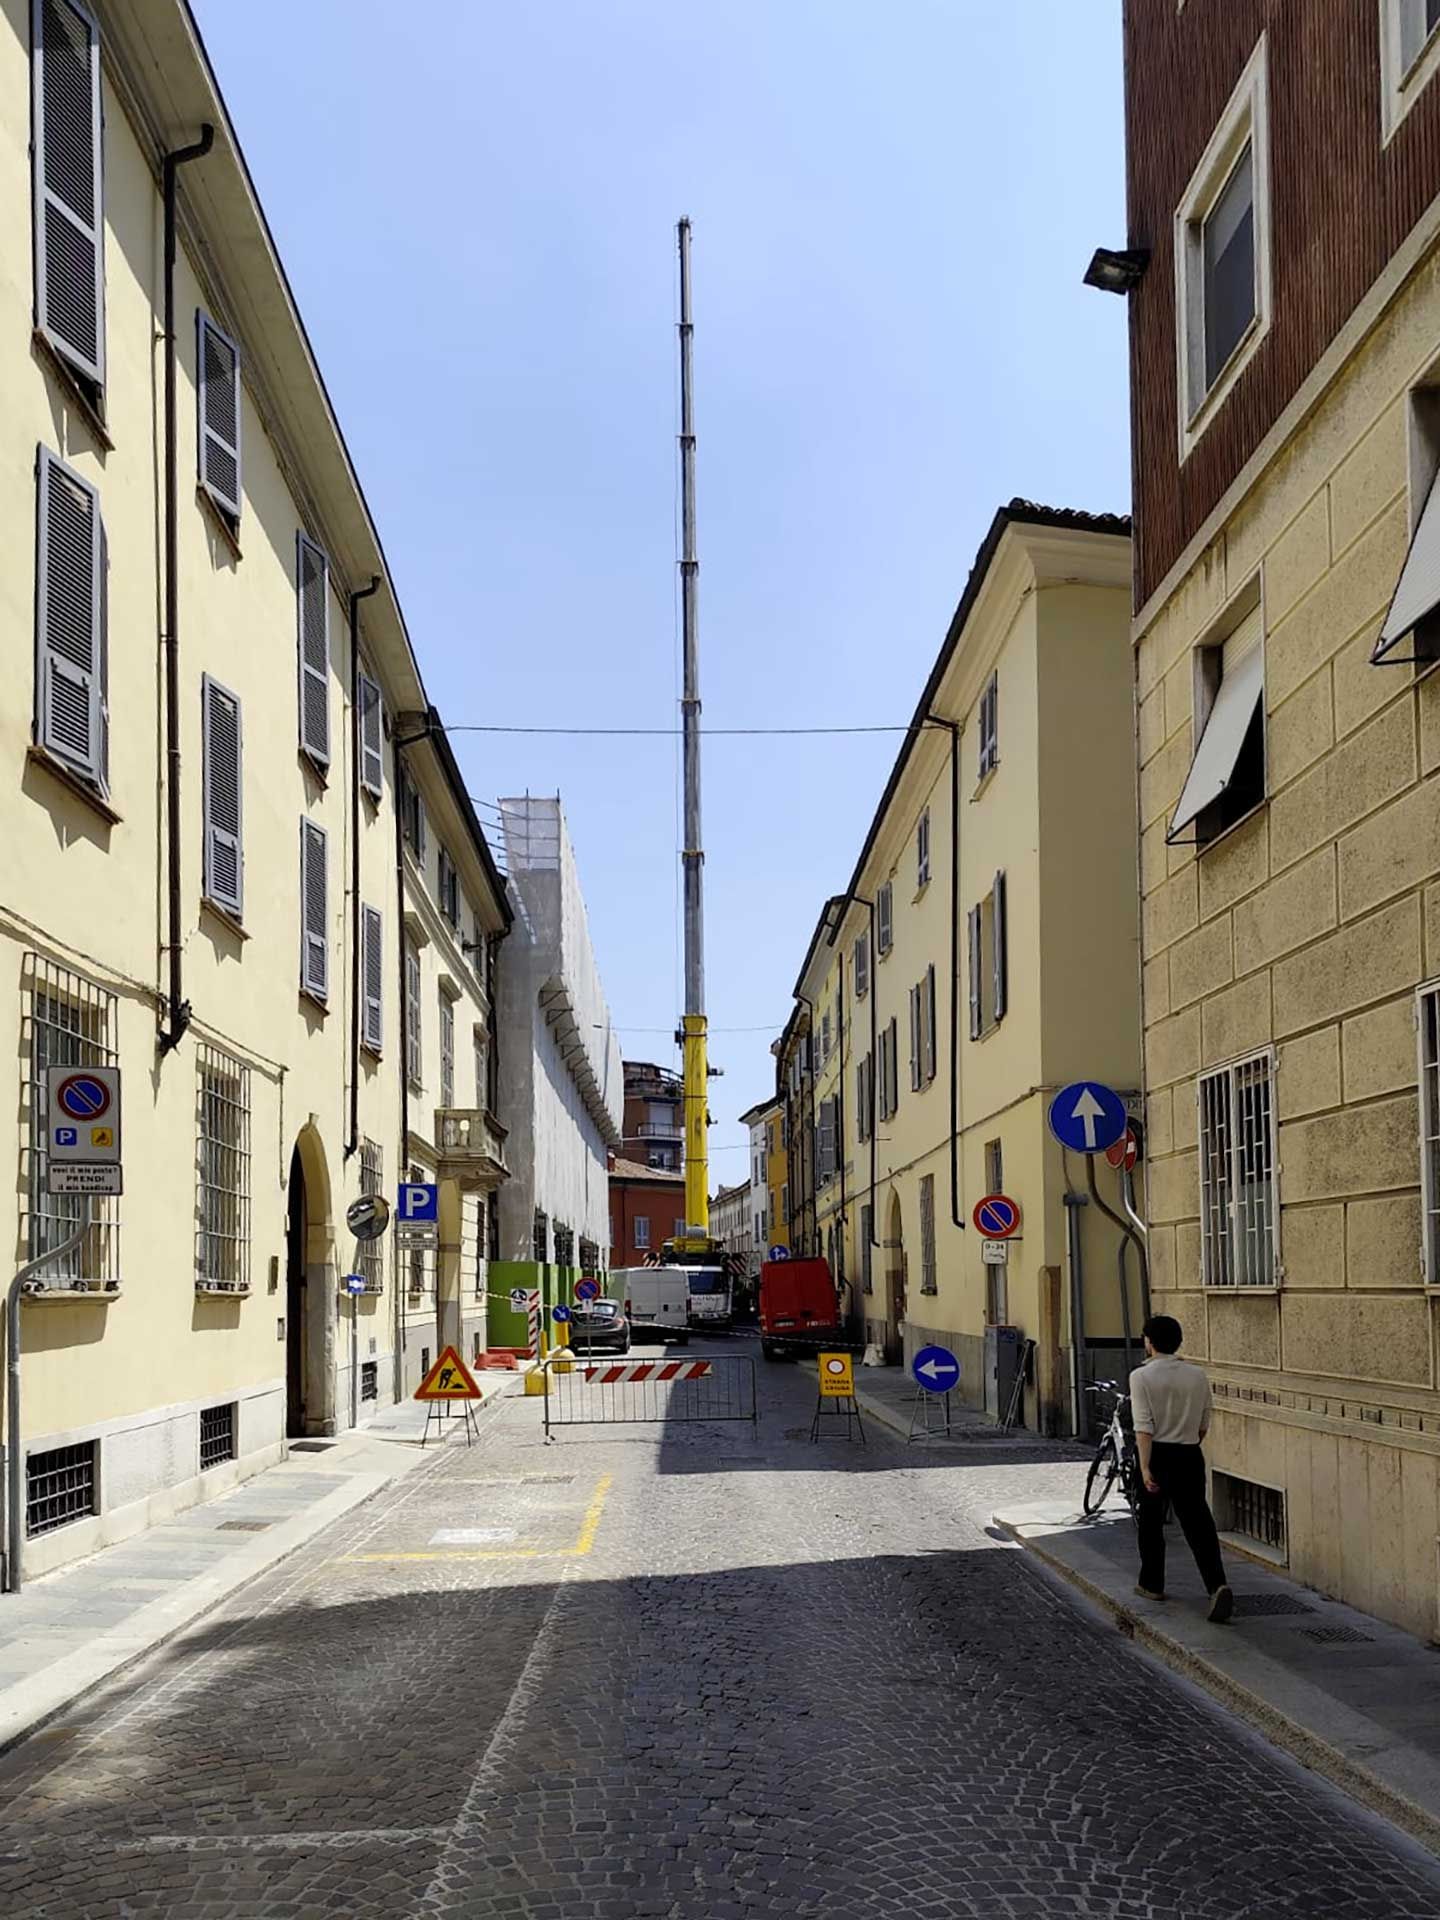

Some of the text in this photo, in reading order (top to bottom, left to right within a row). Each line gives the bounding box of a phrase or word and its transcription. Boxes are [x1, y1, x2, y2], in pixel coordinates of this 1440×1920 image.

[60, 1130, 73, 1143] P
[66, 1175, 105, 1183] PRENDI
[405, 1187, 430, 1217] P
